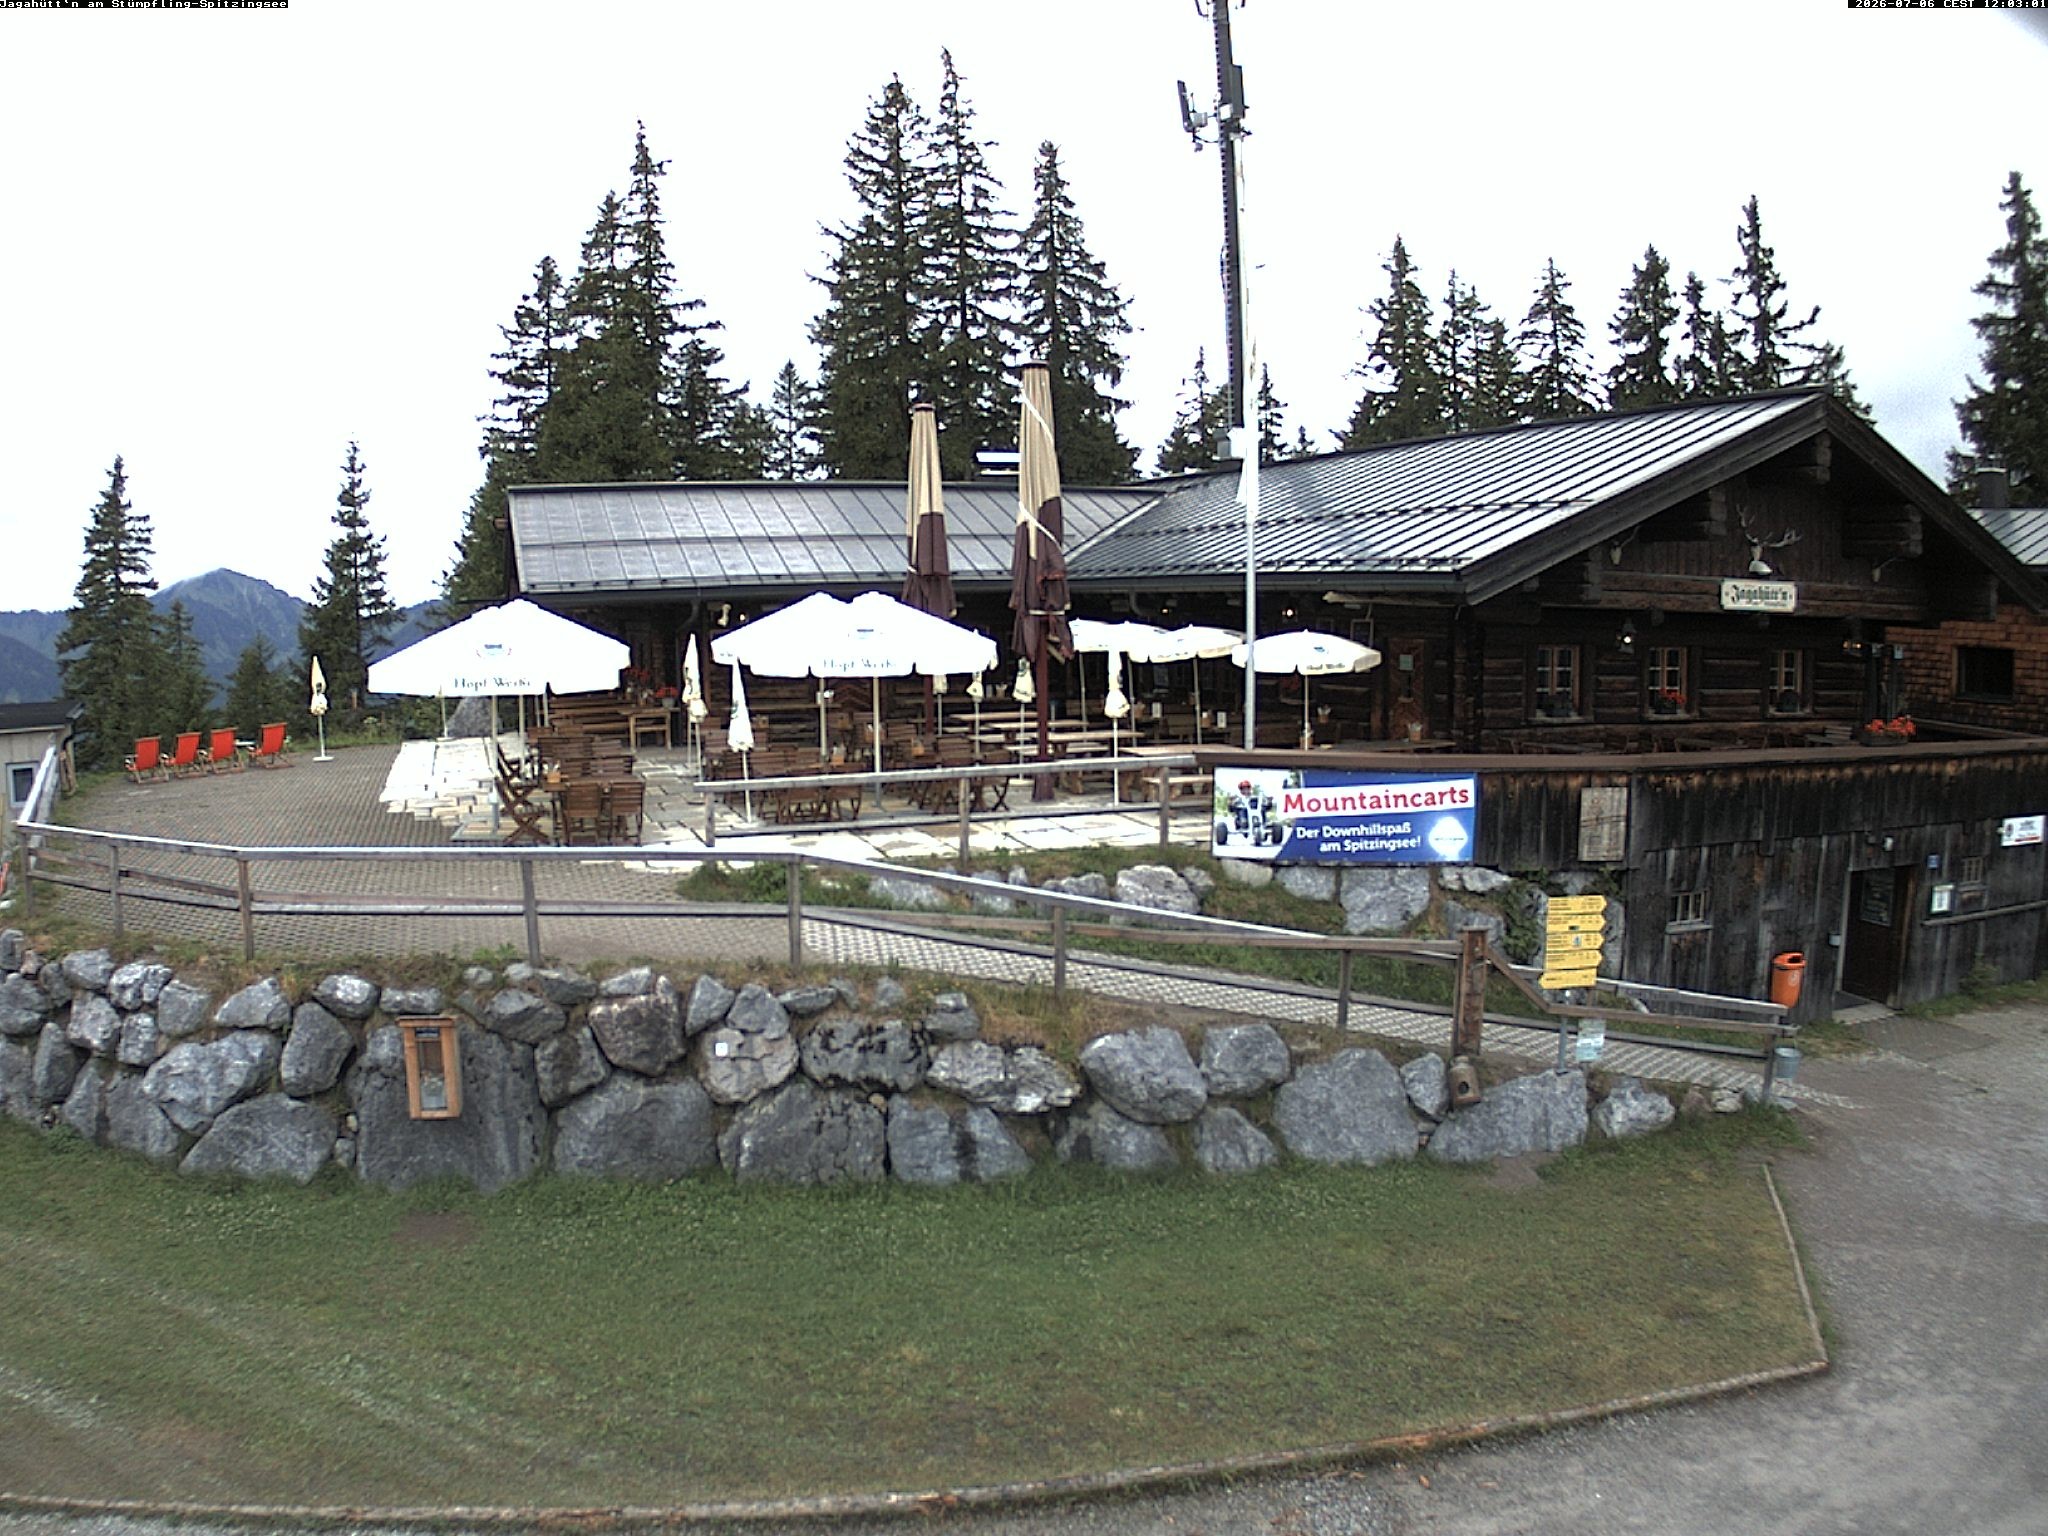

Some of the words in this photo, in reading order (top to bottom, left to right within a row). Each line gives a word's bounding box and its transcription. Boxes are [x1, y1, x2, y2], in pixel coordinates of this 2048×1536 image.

[1282, 786, 1470, 814] Mountaincarts
[1296, 826, 1320, 839] Der
[1322, 821, 1412, 839] Downhillspaß
[1319, 841, 1341, 853] am
[1343, 836, 1422, 853] Spitzingsee!
